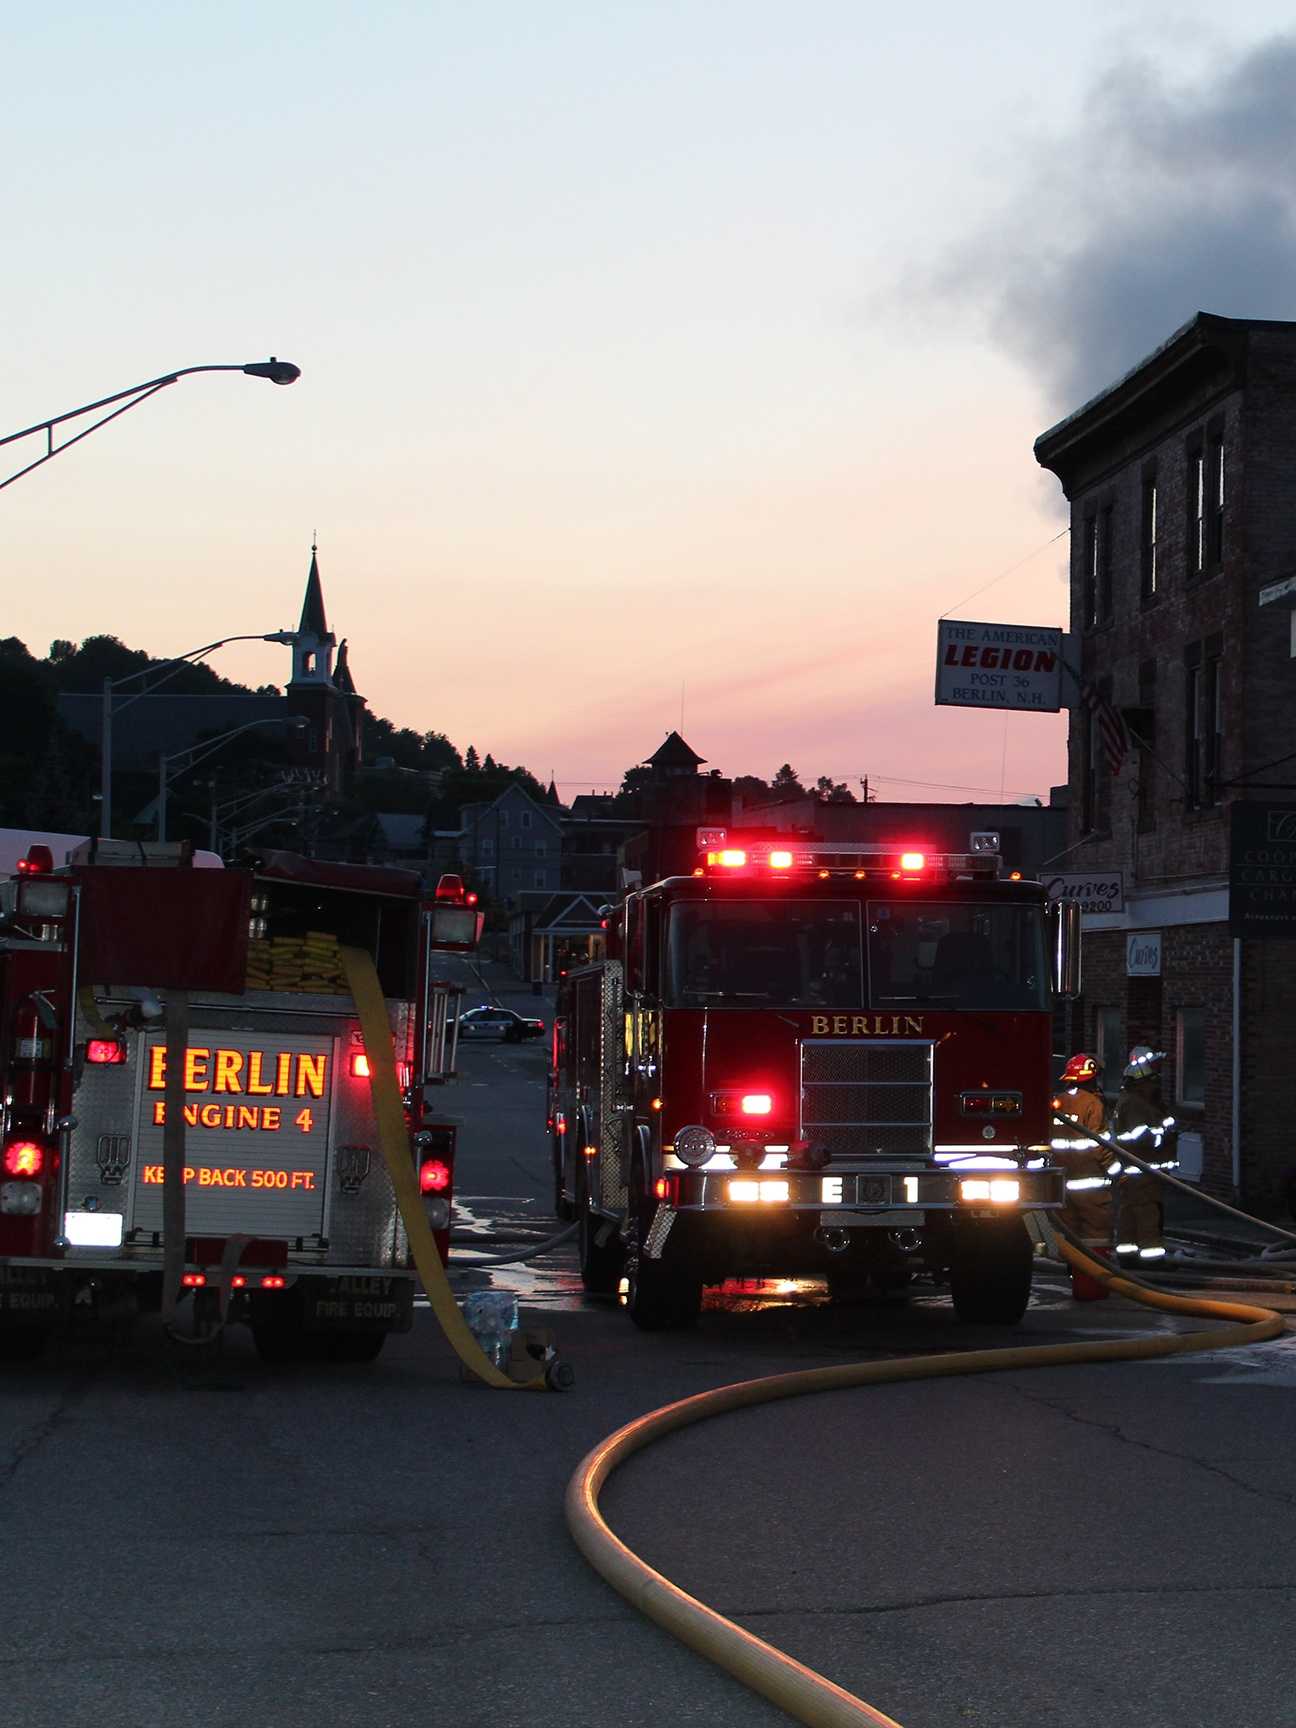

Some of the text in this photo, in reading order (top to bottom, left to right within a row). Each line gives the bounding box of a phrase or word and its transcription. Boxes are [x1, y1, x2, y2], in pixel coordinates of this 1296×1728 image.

[947, 627, 1057, 646] THE AMERICAN
[944, 643, 1057, 672] LEGION
[970, 673, 1030, 688] POST 36
[1017, 691, 1046, 704] N.H.
[1048, 878, 1119, 900] Curves
[811, 1015, 925, 1034] BERLIN
[295, 1108, 313, 1133] 4
[143, 1165, 316, 1189] KEP BACK 500 FT.
[822, 1177, 918, 1203] E 1
[354, 1301, 401, 1319] EQUIP.
